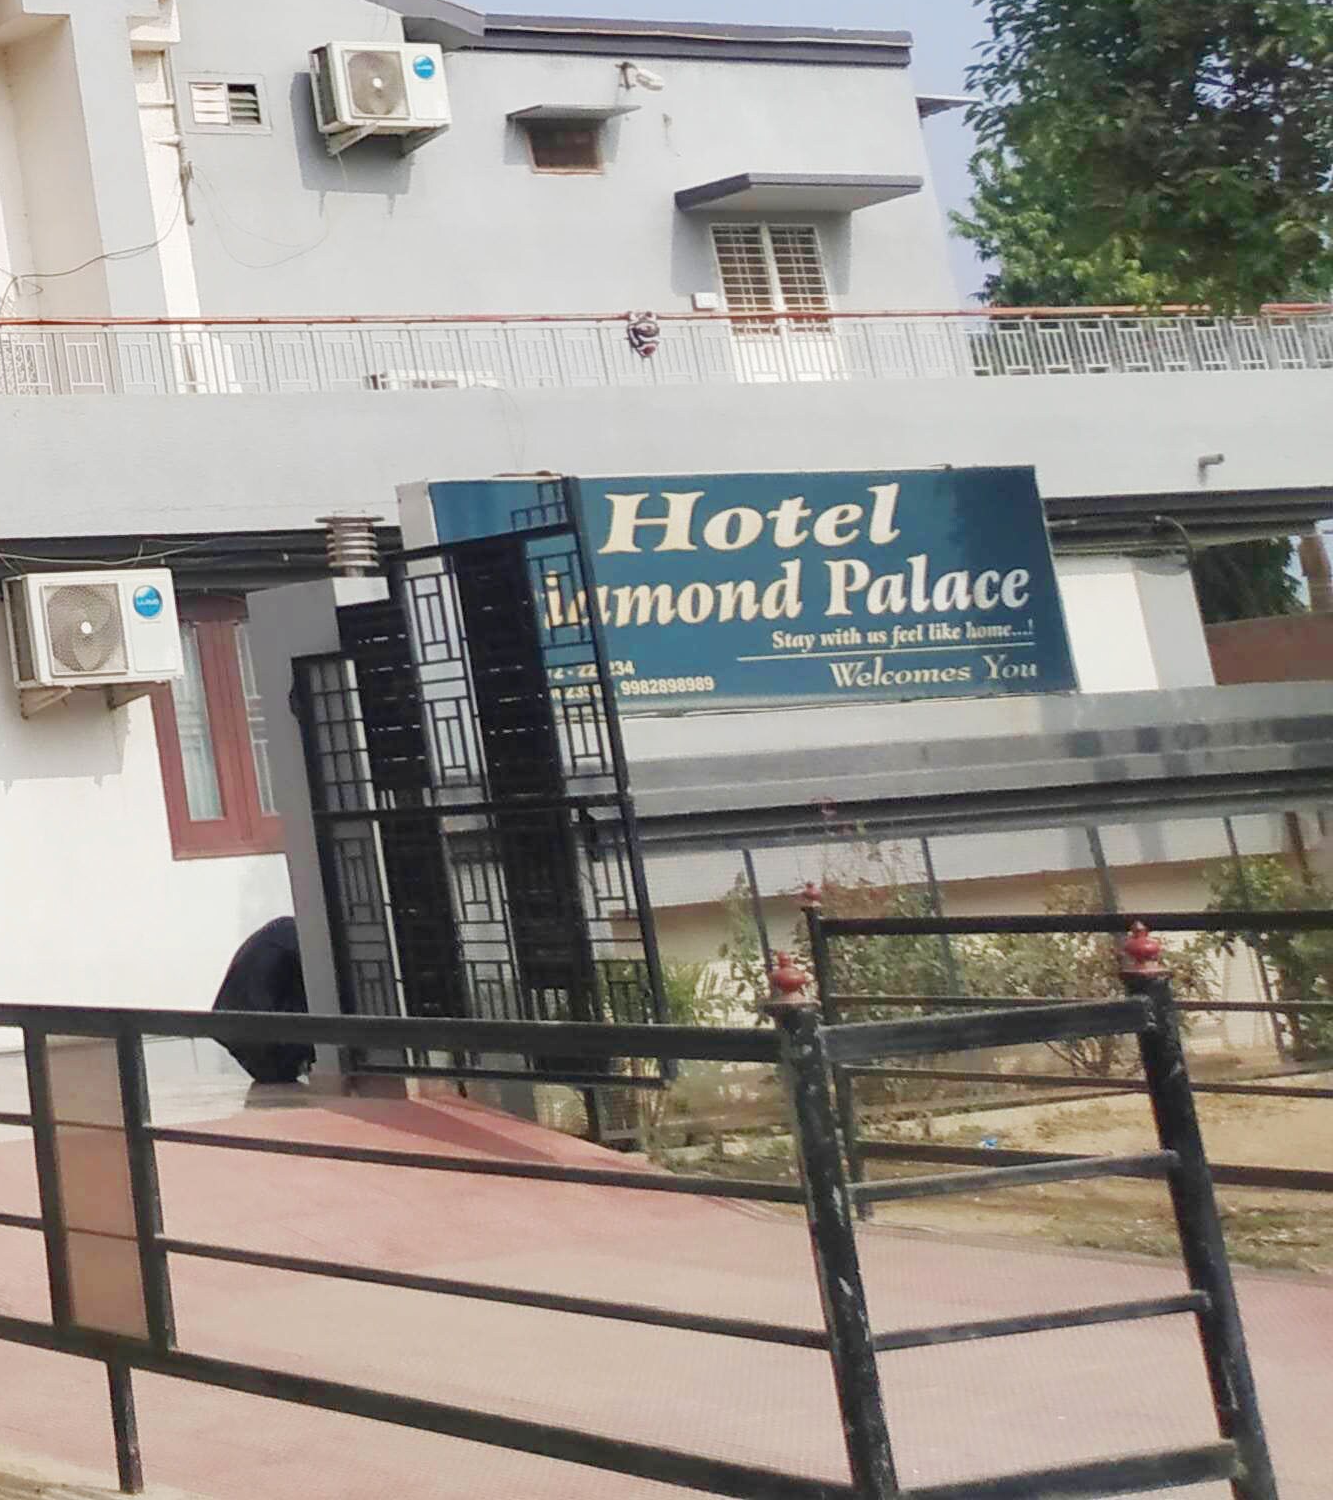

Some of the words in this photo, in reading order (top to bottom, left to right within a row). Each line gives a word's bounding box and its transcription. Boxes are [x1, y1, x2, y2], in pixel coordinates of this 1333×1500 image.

[597, 482, 901, 555] Hotel
[823, 553, 1031, 617] Palace
[772, 630, 815, 653] Stay
[820, 626, 861, 646] with
[867, 630, 887, 644] us
[890, 624, 924, 649] feel
[929, 621, 961, 641] like
[620, 676, 714, 697] 9982898989
[829, 656, 971, 688] Welcomes
[983, 654, 1038, 680] You
